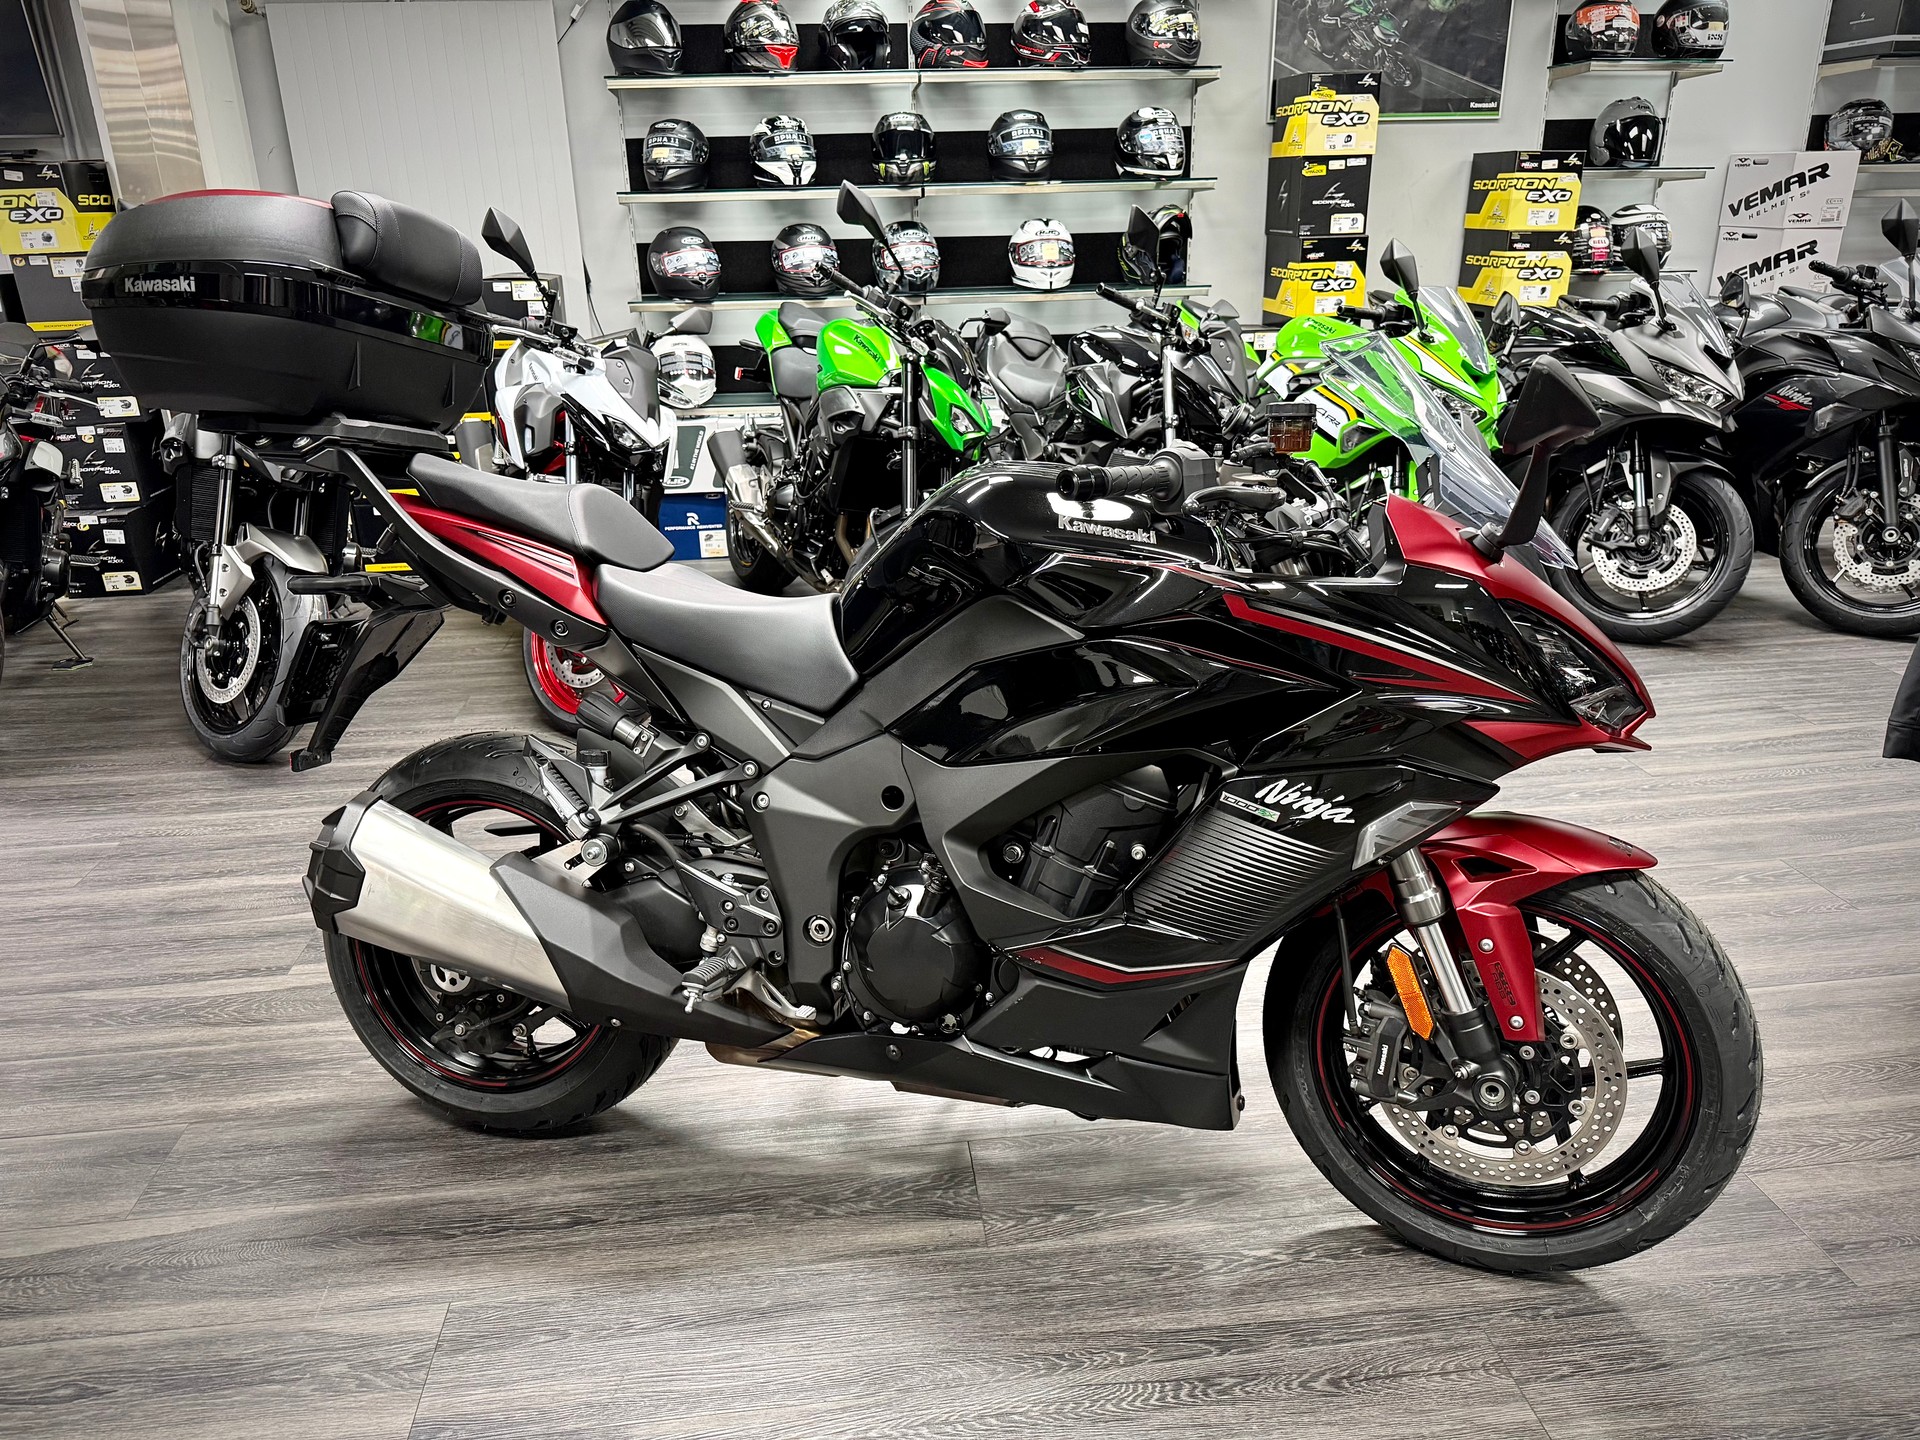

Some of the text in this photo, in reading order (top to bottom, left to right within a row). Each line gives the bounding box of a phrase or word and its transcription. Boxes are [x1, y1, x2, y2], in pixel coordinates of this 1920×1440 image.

[1276, 100, 1352, 117] SCORPION
[1472, 178, 1556, 191] SCORPION
[1728, 162, 1831, 218] VEMAR
[1270, 267, 1337, 280] SCORPION
[1465, 255, 1547, 268] SCORPION
[124, 276, 196, 292] Kawasaki
[853, 334, 881, 363] Kawasaki
[1776, 384, 1813, 405] Ninja
[1058, 514, 1157, 545] Kawasaki
[1221, 793, 1279, 821] 1000SX
[1254, 778, 1356, 824] Ninja
[1376, 1043, 1389, 1076] Kawasaki
